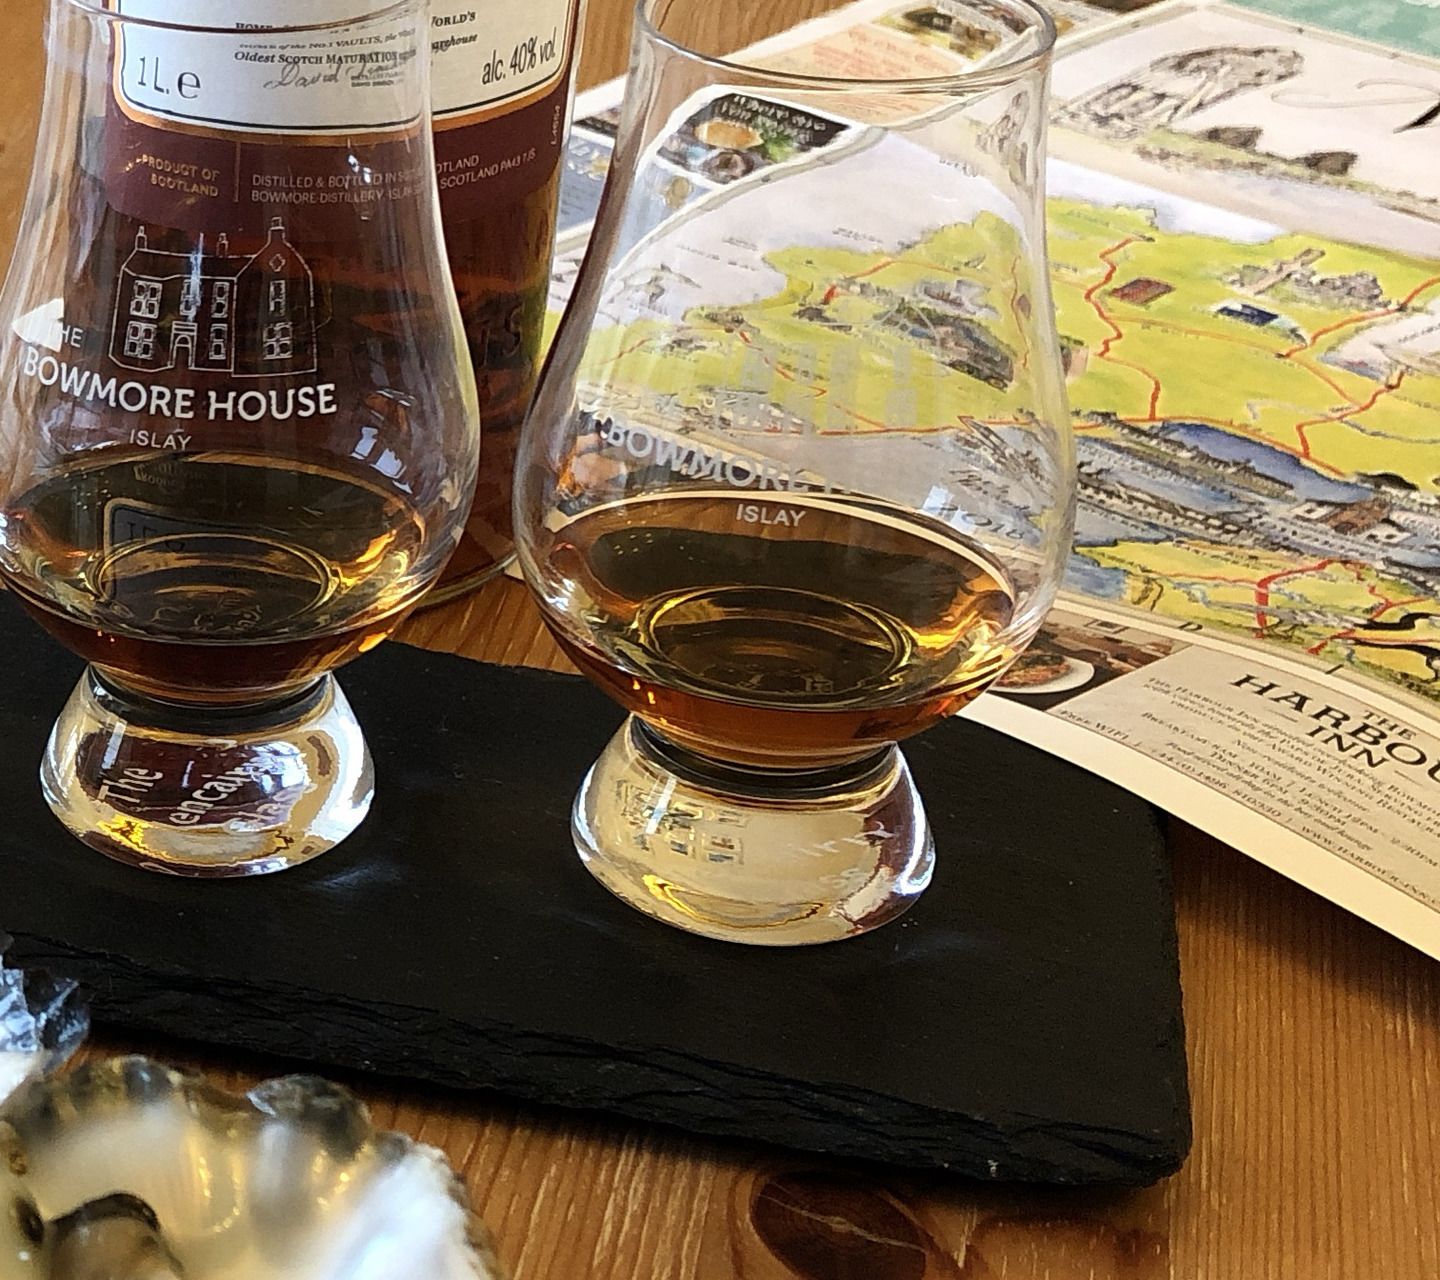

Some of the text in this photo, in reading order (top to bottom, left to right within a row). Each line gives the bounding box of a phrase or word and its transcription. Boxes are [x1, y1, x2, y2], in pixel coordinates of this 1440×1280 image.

[234, 51, 276, 64] Oldest
[278, 53, 325, 65] SCOTCH
[482, 49, 506, 85] alc.
[510, 35, 538, 76] 40%
[141, 153, 221, 182] PRODUCT OF
[252, 174, 313, 189] DISTILLED
[150, 172, 219, 198] SCOTLAND
[251, 189, 318, 204] BOWMORE
[440, 164, 499, 191] SCOTLAND
[23, 347, 338, 422] BOWMORE HOUSE
[129, 428, 192, 452] ISLAY
[736, 503, 807, 527] ISLAY
[1361, 710, 1417, 741] THE
[1305, 725, 1390, 768] INN
[99, 768, 165, 805] The
